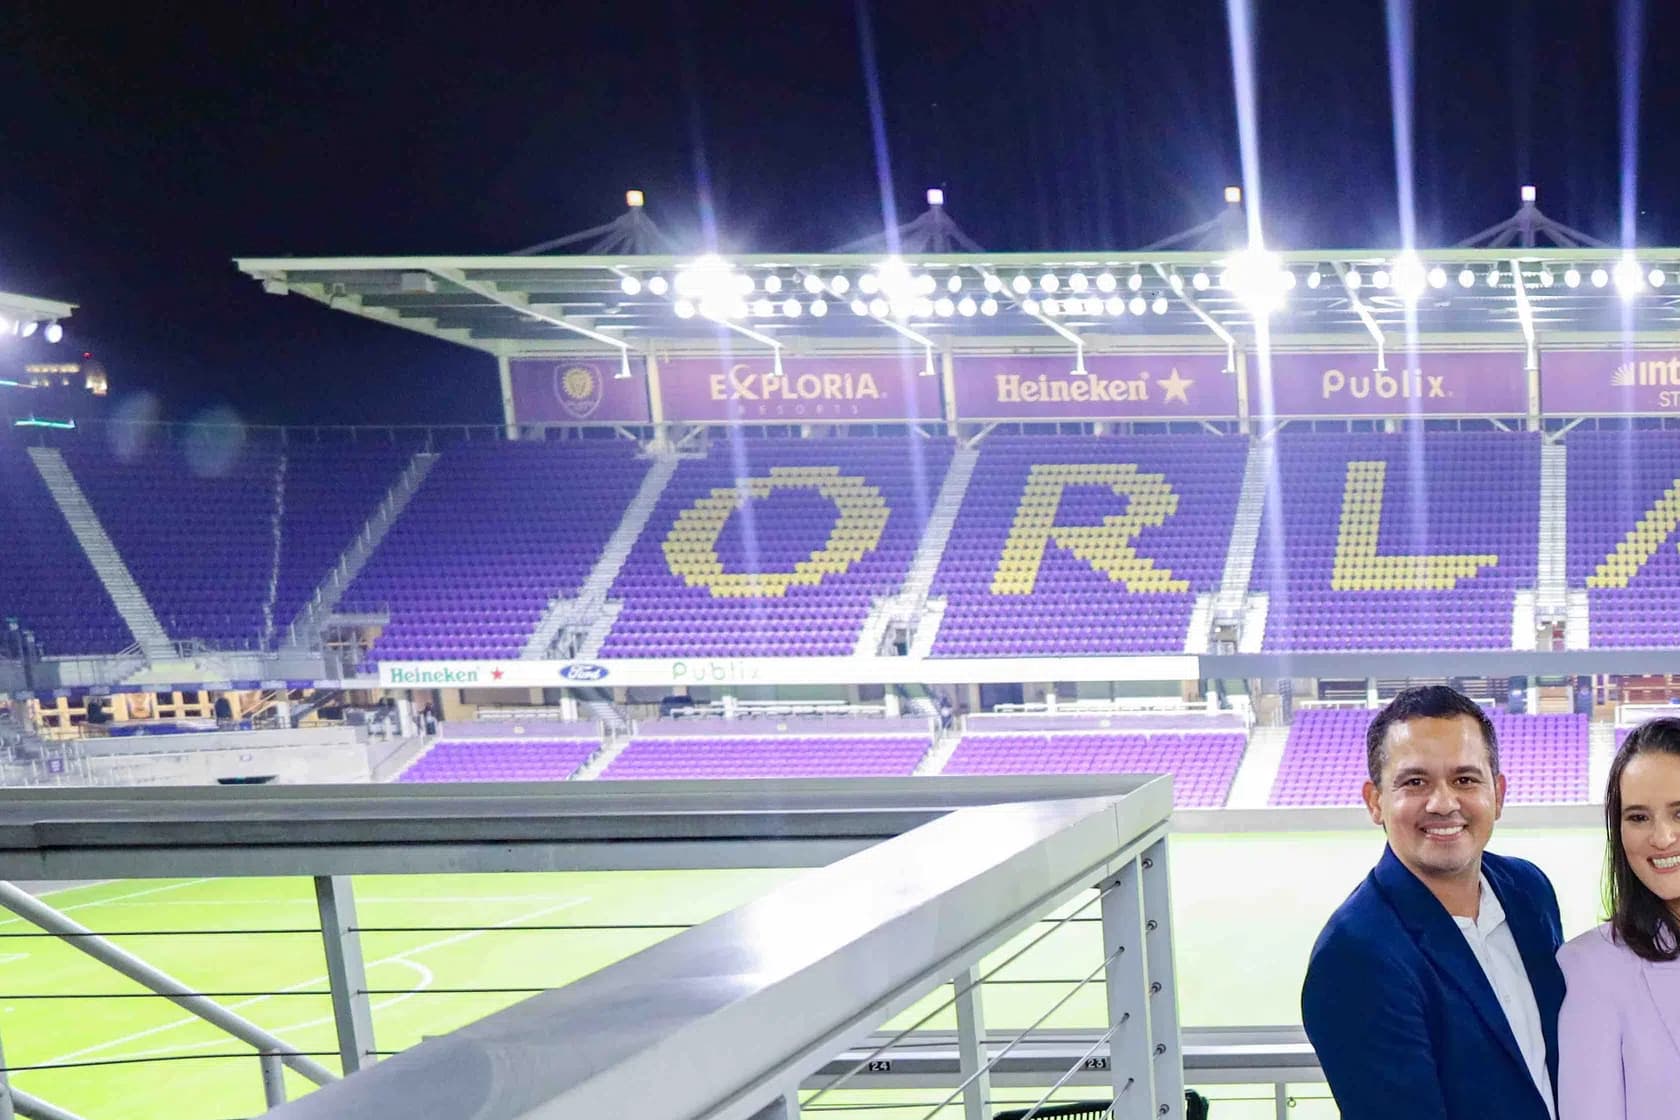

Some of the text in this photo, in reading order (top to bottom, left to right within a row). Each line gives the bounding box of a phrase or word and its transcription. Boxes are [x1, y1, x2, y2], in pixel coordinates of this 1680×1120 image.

[710, 365, 880, 401] EXPLORIA
[996, 371, 1147, 403] Heineken
[1322, 369, 1446, 398] Publix
[390, 667, 478, 684] Heineken
[567, 665, 600, 680] Ford
[871, 1061, 888, 1071] 24
